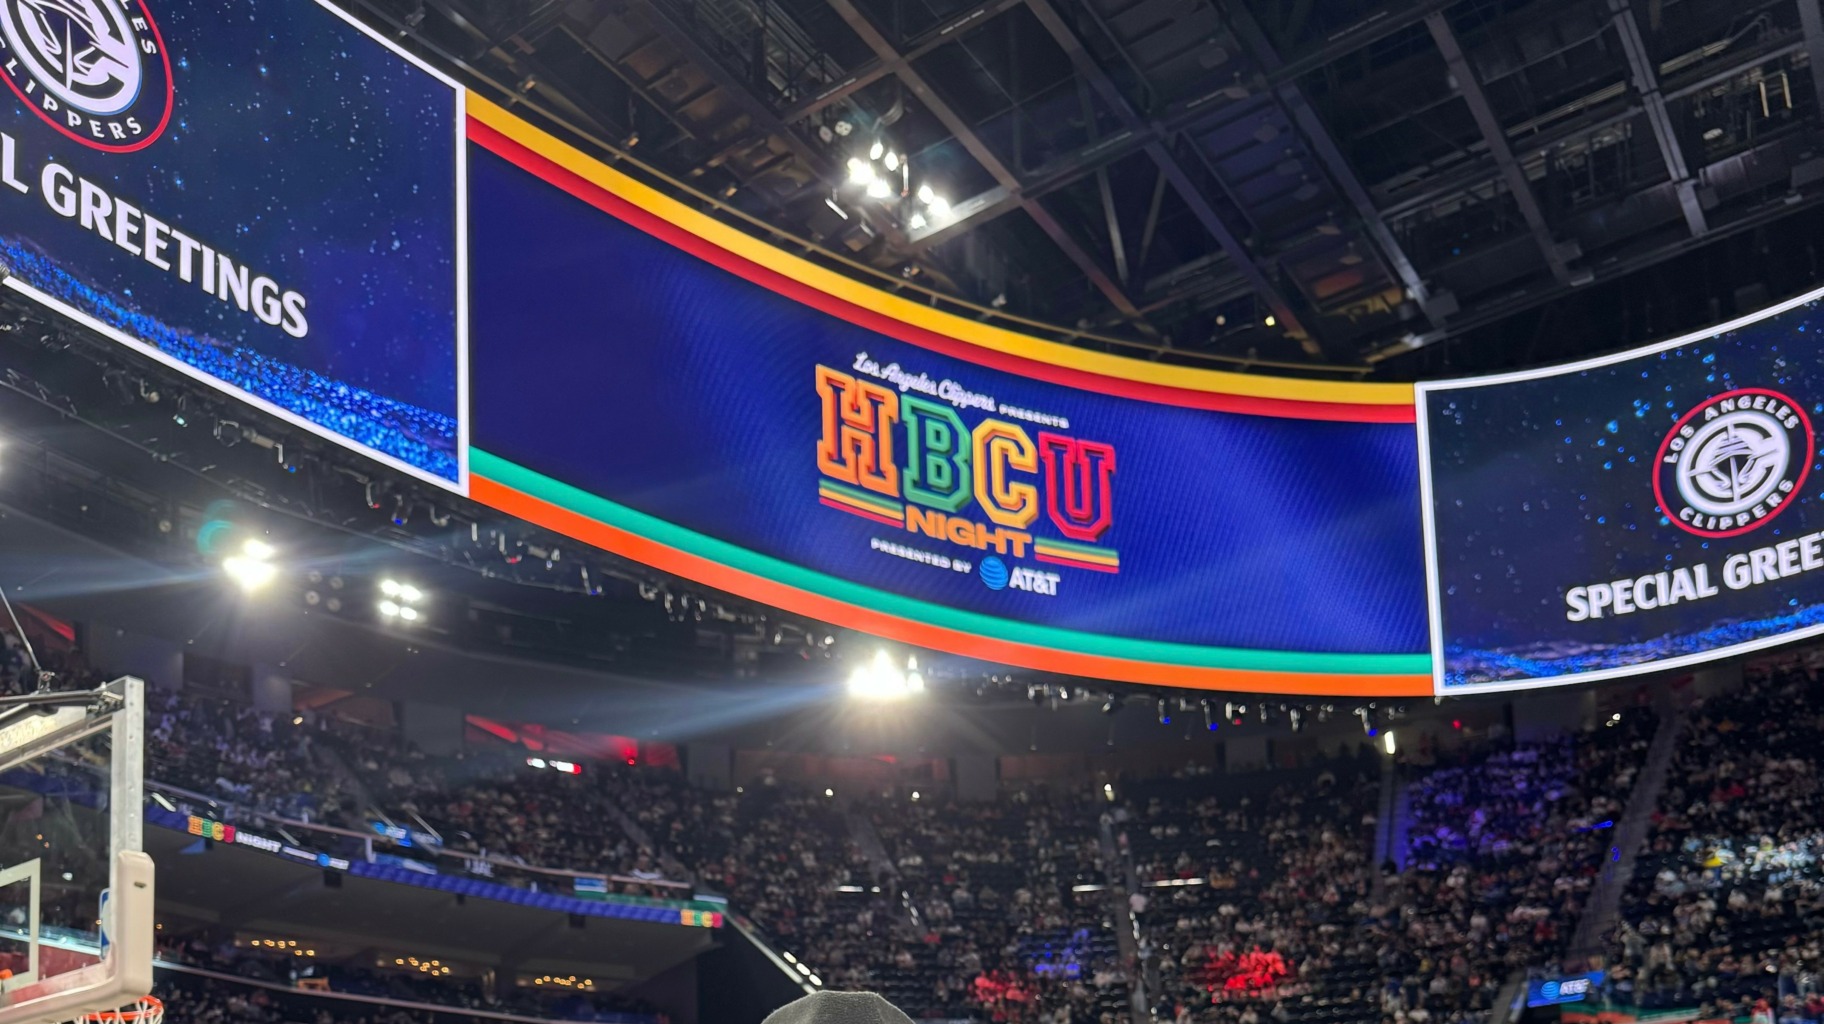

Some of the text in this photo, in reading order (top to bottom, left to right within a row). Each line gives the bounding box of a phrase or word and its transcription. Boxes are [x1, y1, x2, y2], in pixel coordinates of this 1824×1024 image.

[0, 37, 142, 140] LIPPERS
[41, 162, 309, 338] GREETINGS
[853, 351, 1069, 429] Los Angeles Clippers PRESENTS
[815, 363, 1116, 542] HBCU
[1663, 395, 1800, 464] LOS ANGELES
[905, 505, 1032, 558] NIGHT
[1679, 478, 1795, 531] CLIPPERS
[870, 537, 972, 574] PRESENTED BY
[1009, 566, 1061, 596] AT&T
[1565, 530, 1824, 622] SPECIAL GREE
